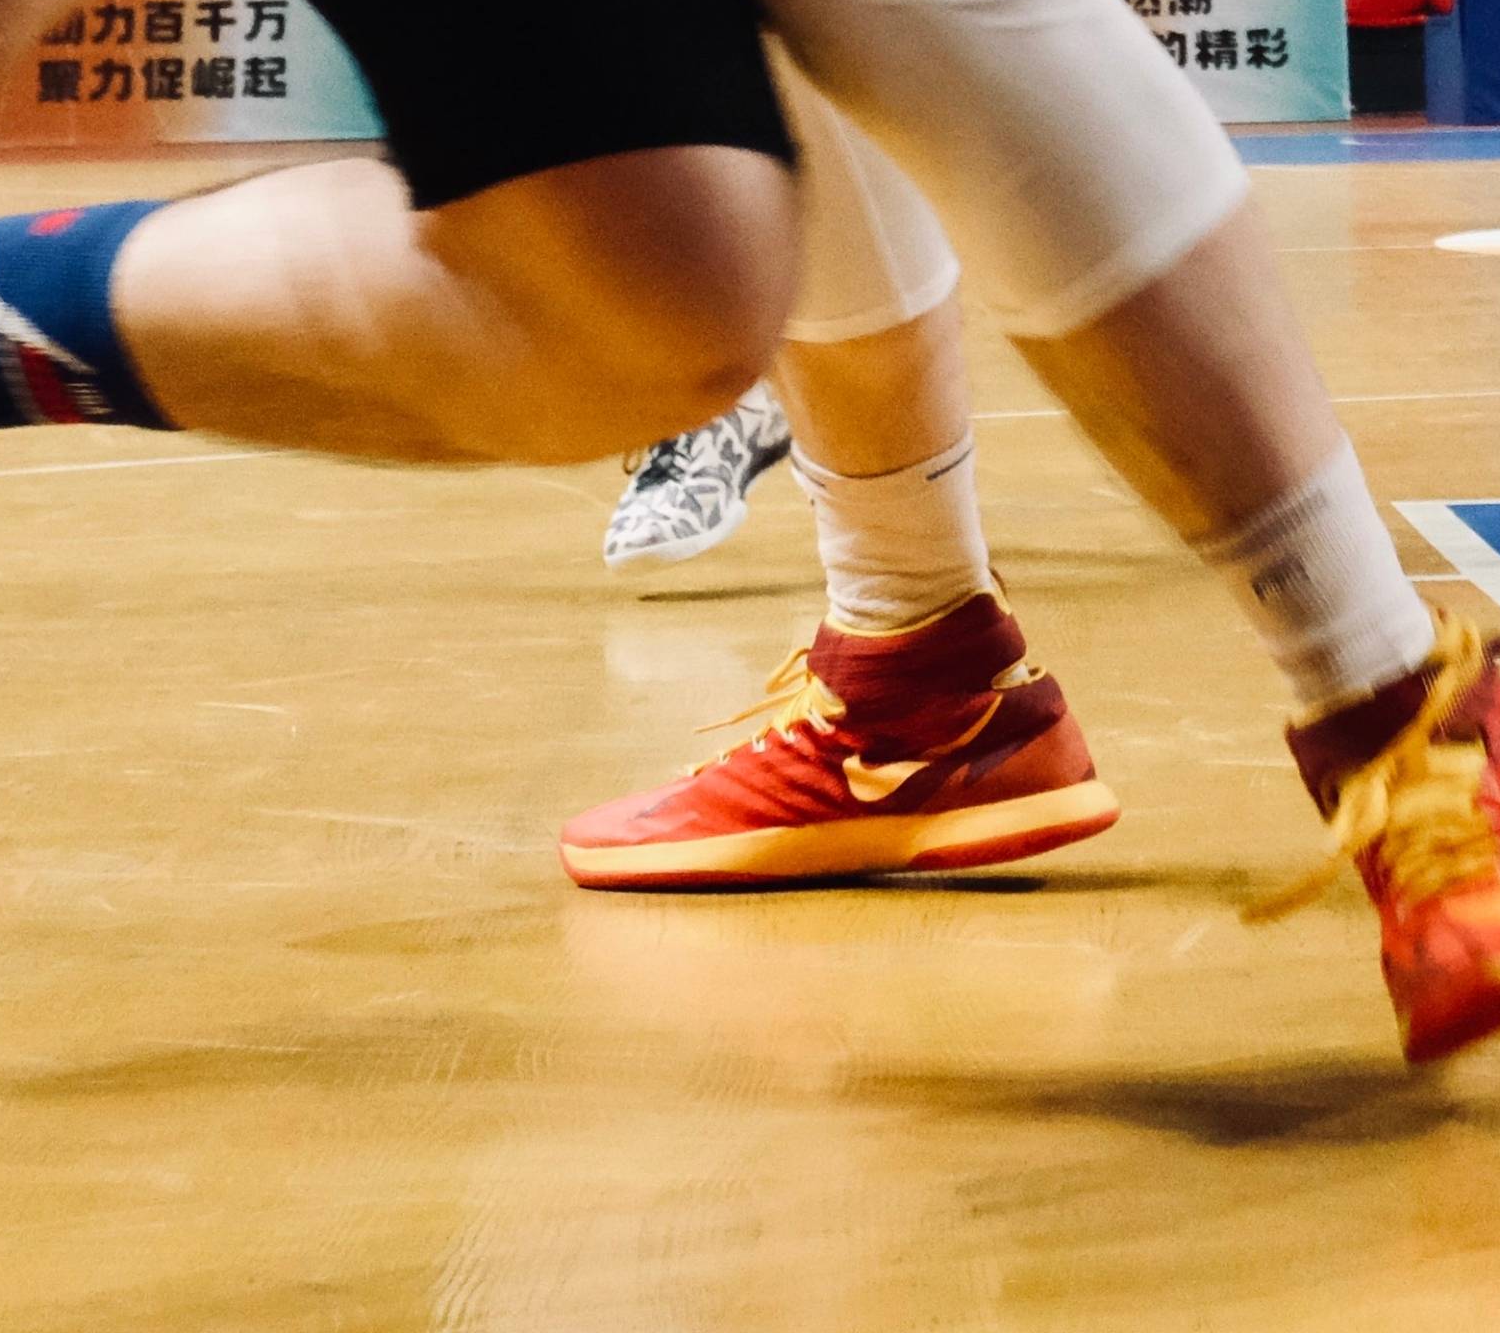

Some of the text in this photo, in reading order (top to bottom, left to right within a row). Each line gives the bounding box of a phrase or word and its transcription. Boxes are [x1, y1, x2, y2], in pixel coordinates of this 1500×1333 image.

[38, 55, 288, 102] 聚力促崛起
